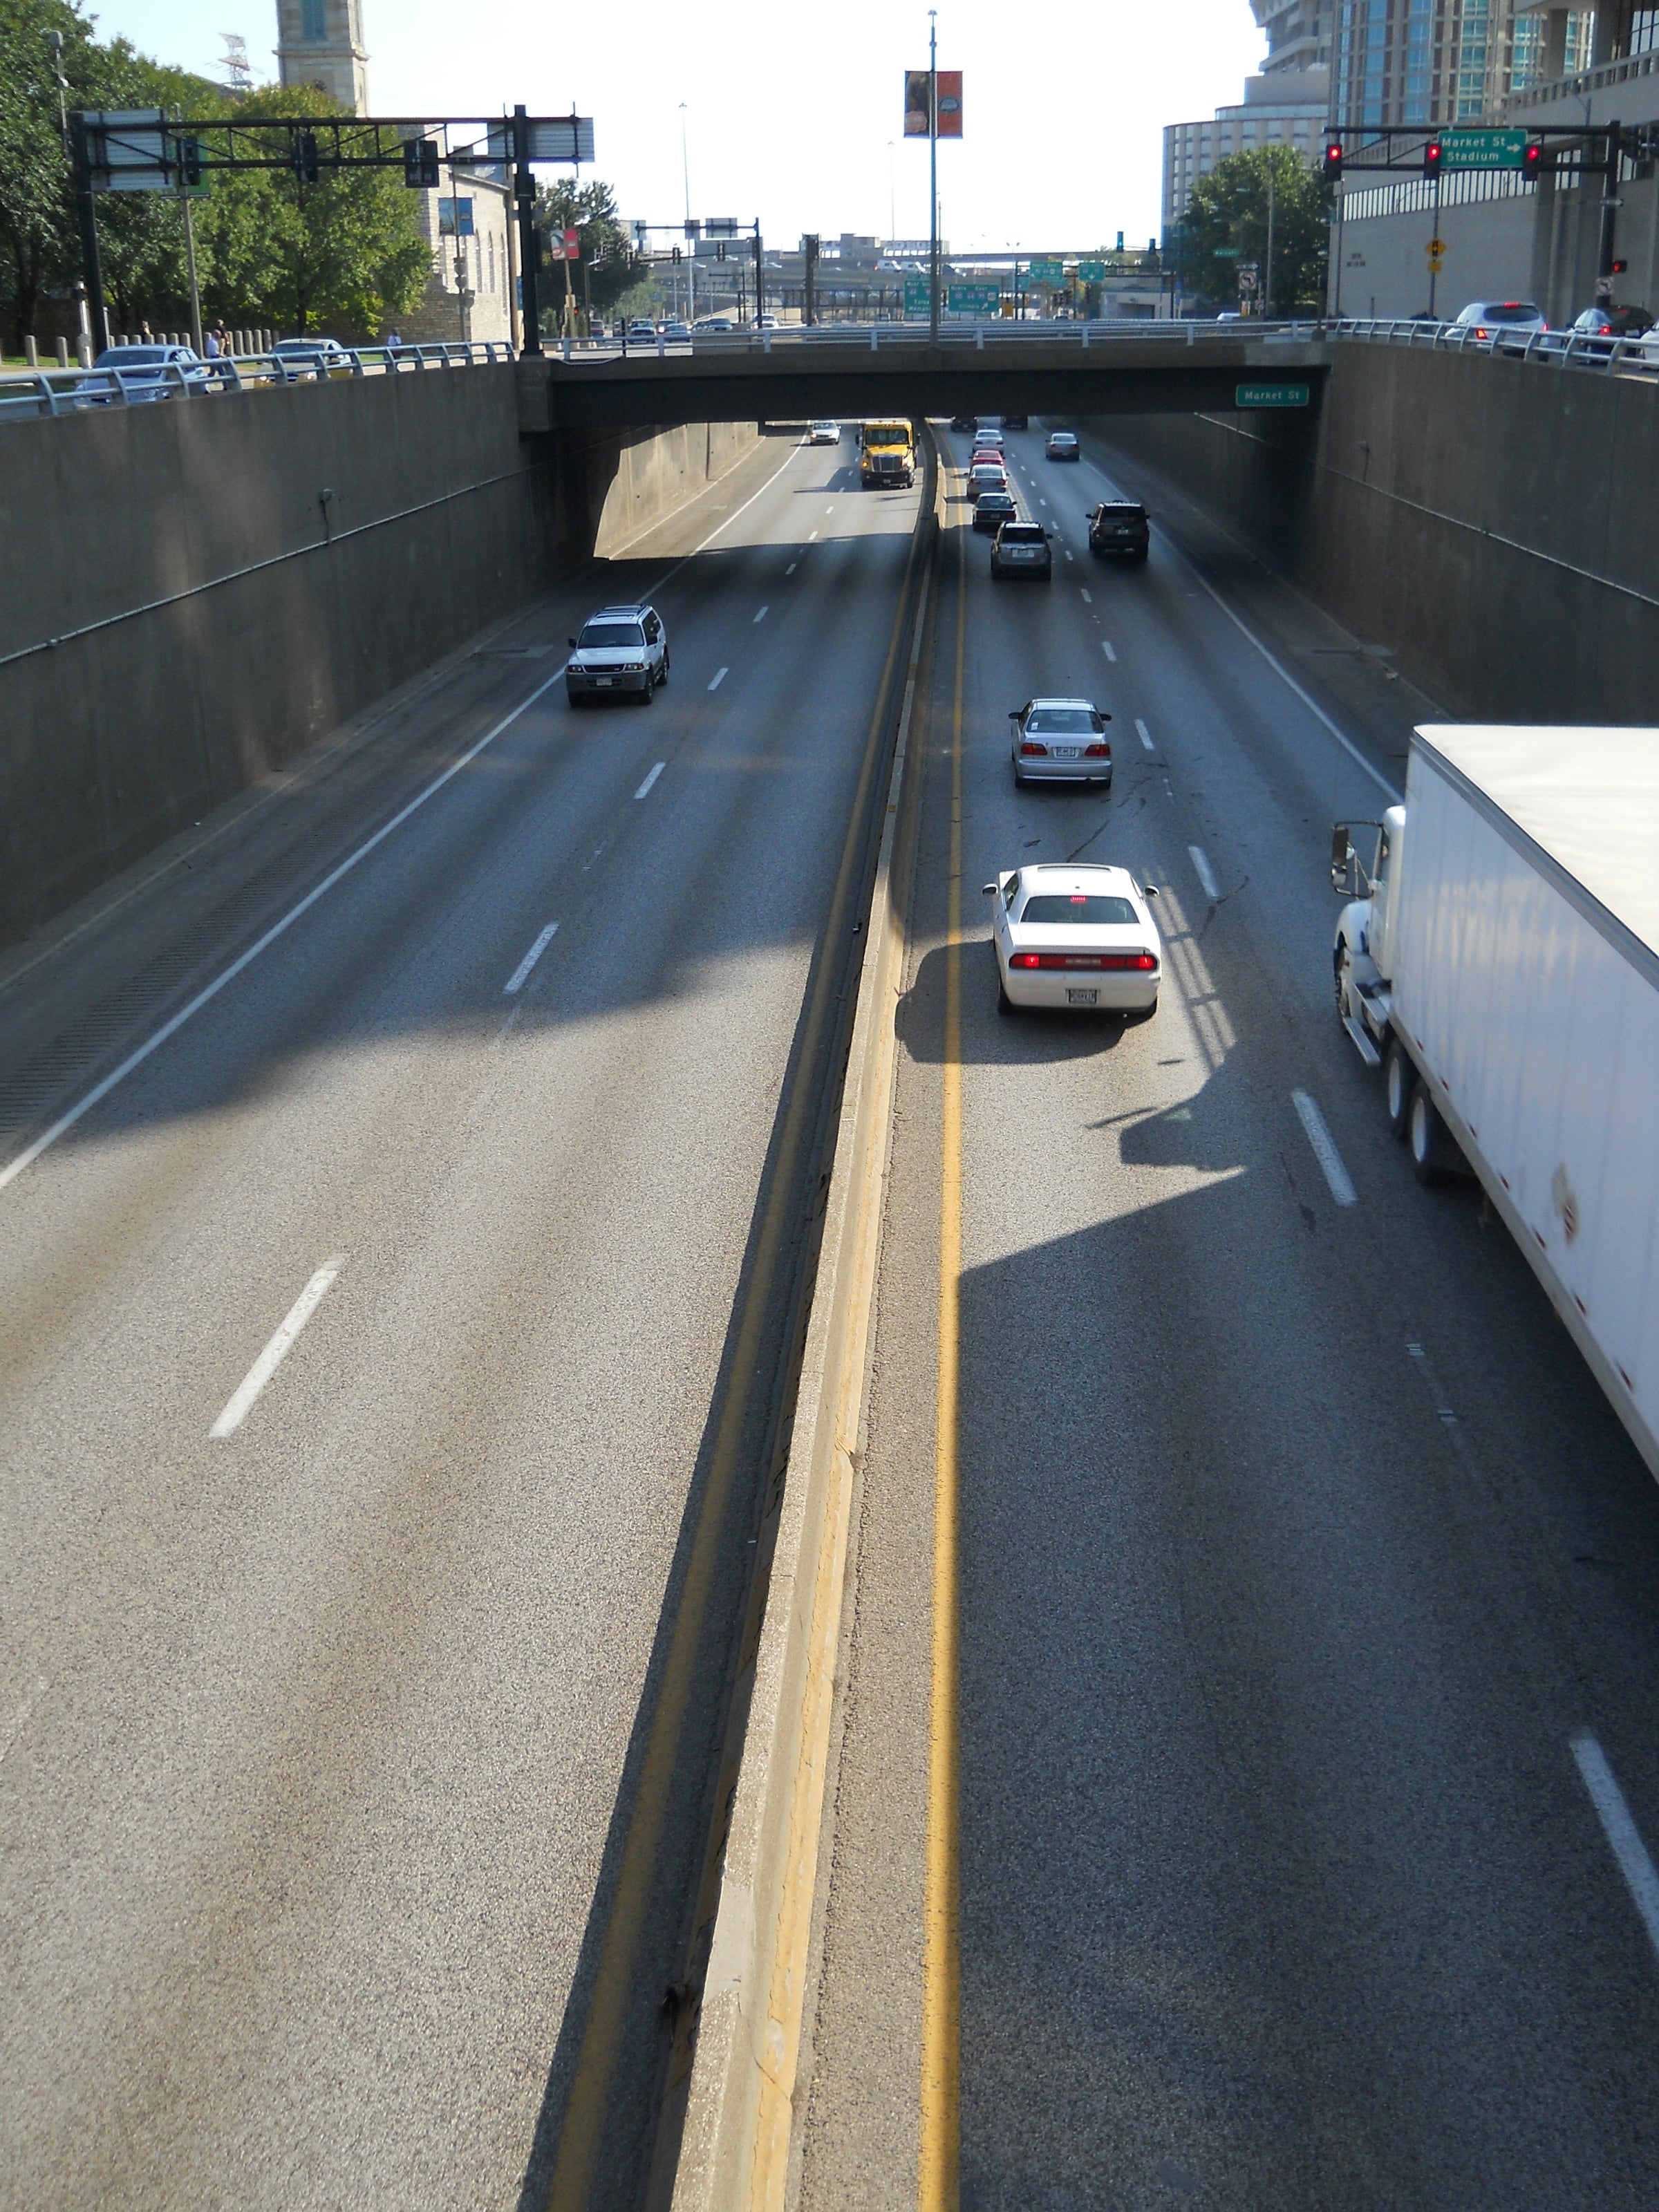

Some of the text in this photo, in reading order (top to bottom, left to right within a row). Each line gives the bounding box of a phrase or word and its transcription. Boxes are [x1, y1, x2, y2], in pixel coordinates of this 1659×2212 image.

[1442, 136, 1506, 147] Market St
[1447, 151, 1499, 161] Stadium
[1245, 391, 1300, 400] Market St
